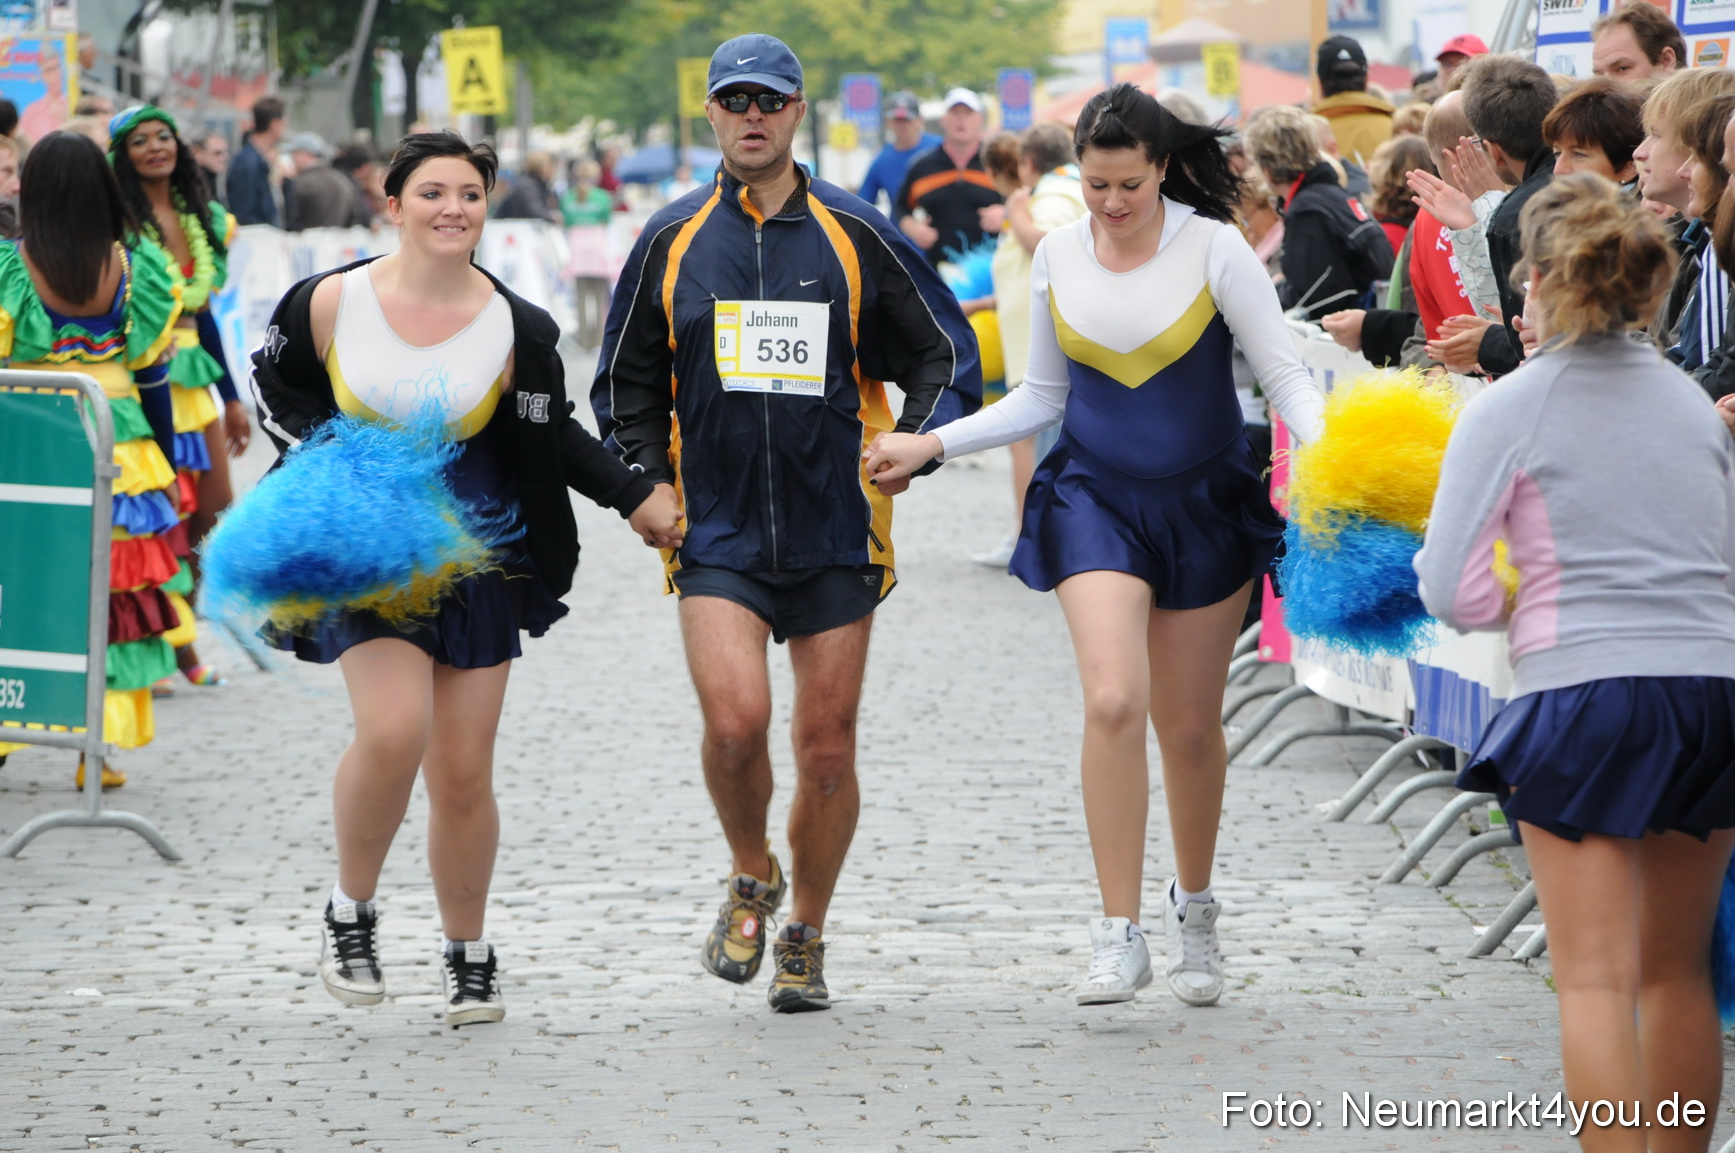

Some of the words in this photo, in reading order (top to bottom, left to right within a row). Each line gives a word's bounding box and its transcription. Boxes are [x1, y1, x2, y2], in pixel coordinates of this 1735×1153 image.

[459, 55, 490, 94] A
[746, 310, 798, 328] Johann
[719, 336, 727, 349] D
[757, 338, 809, 364] 536
[783, 379, 823, 390] PFLEIDERER
